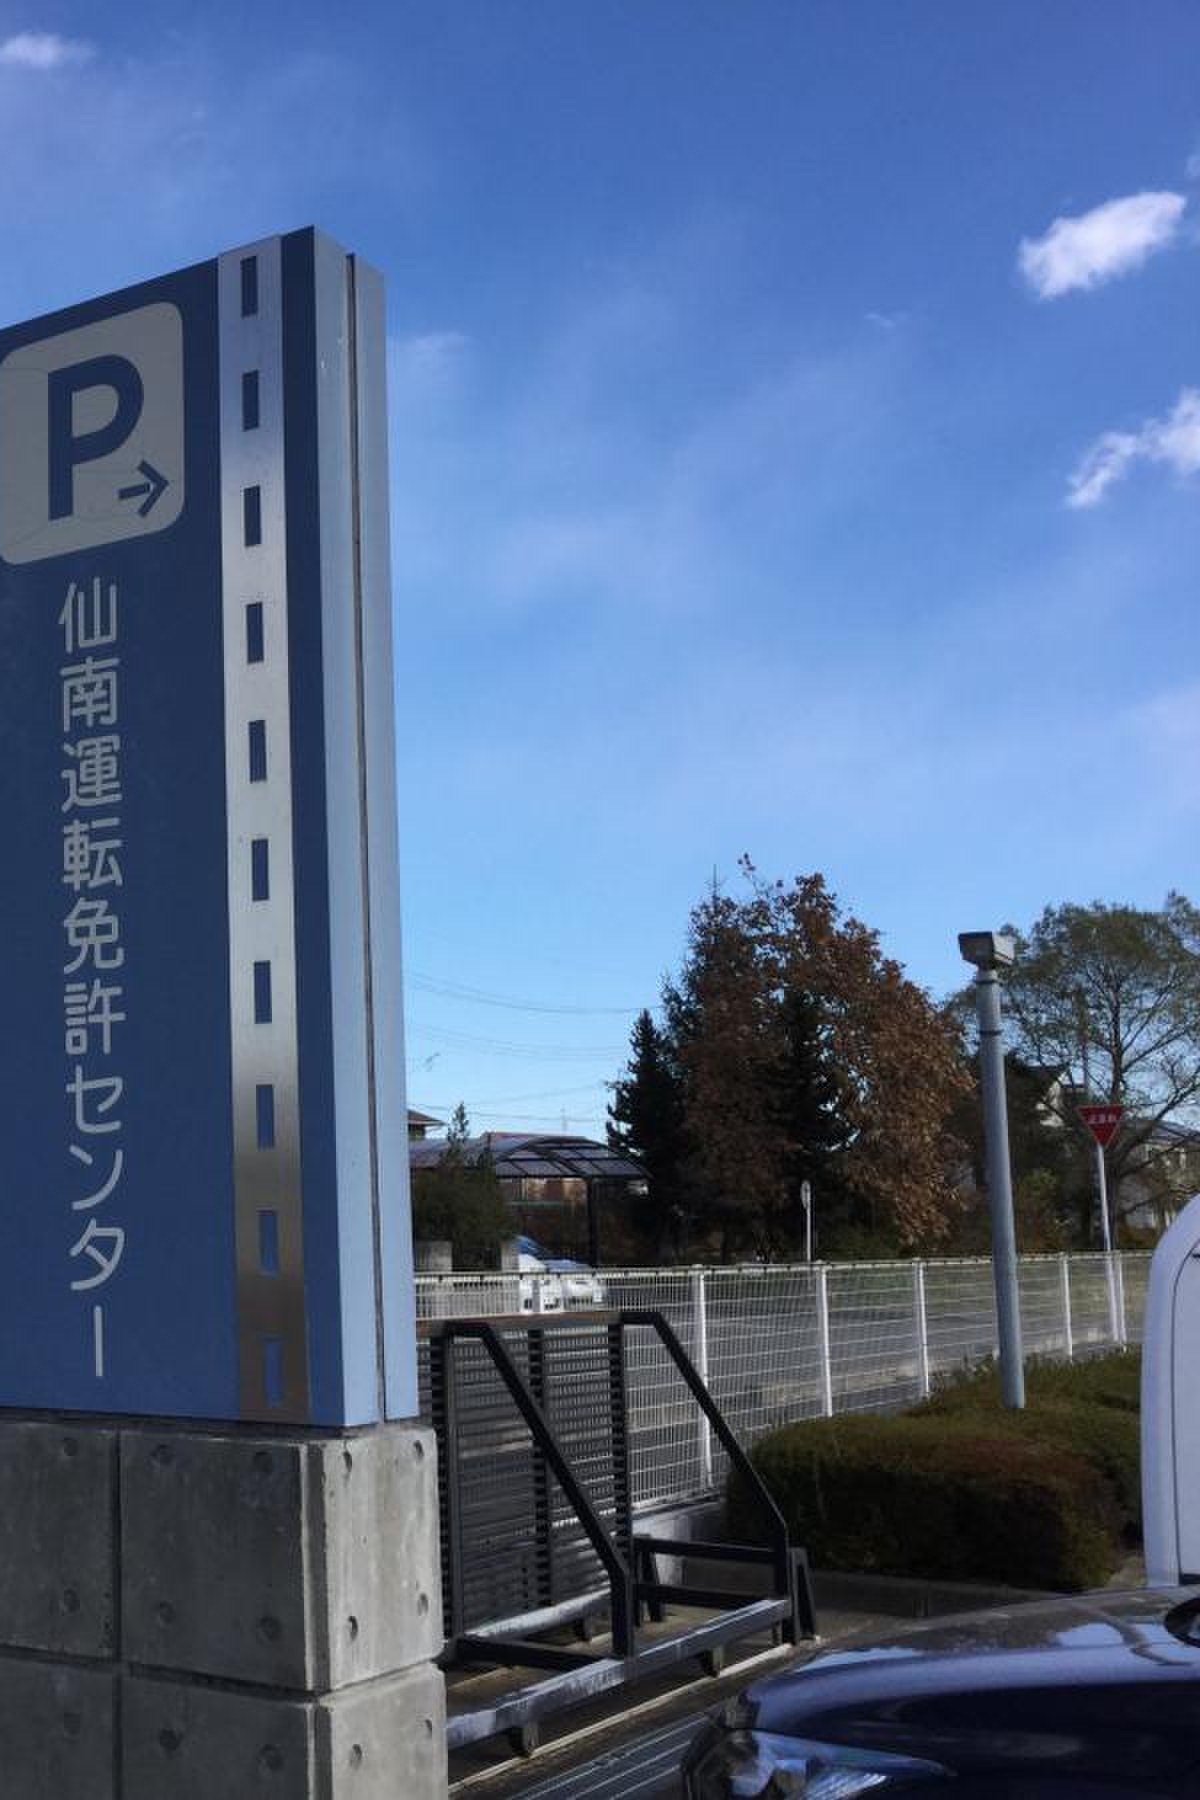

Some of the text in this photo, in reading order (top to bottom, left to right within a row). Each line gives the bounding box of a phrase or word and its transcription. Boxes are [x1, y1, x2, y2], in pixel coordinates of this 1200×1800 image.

[47, 353, 145, 521] P
[58, 576, 127, 1377] 仙南運転免許センター
